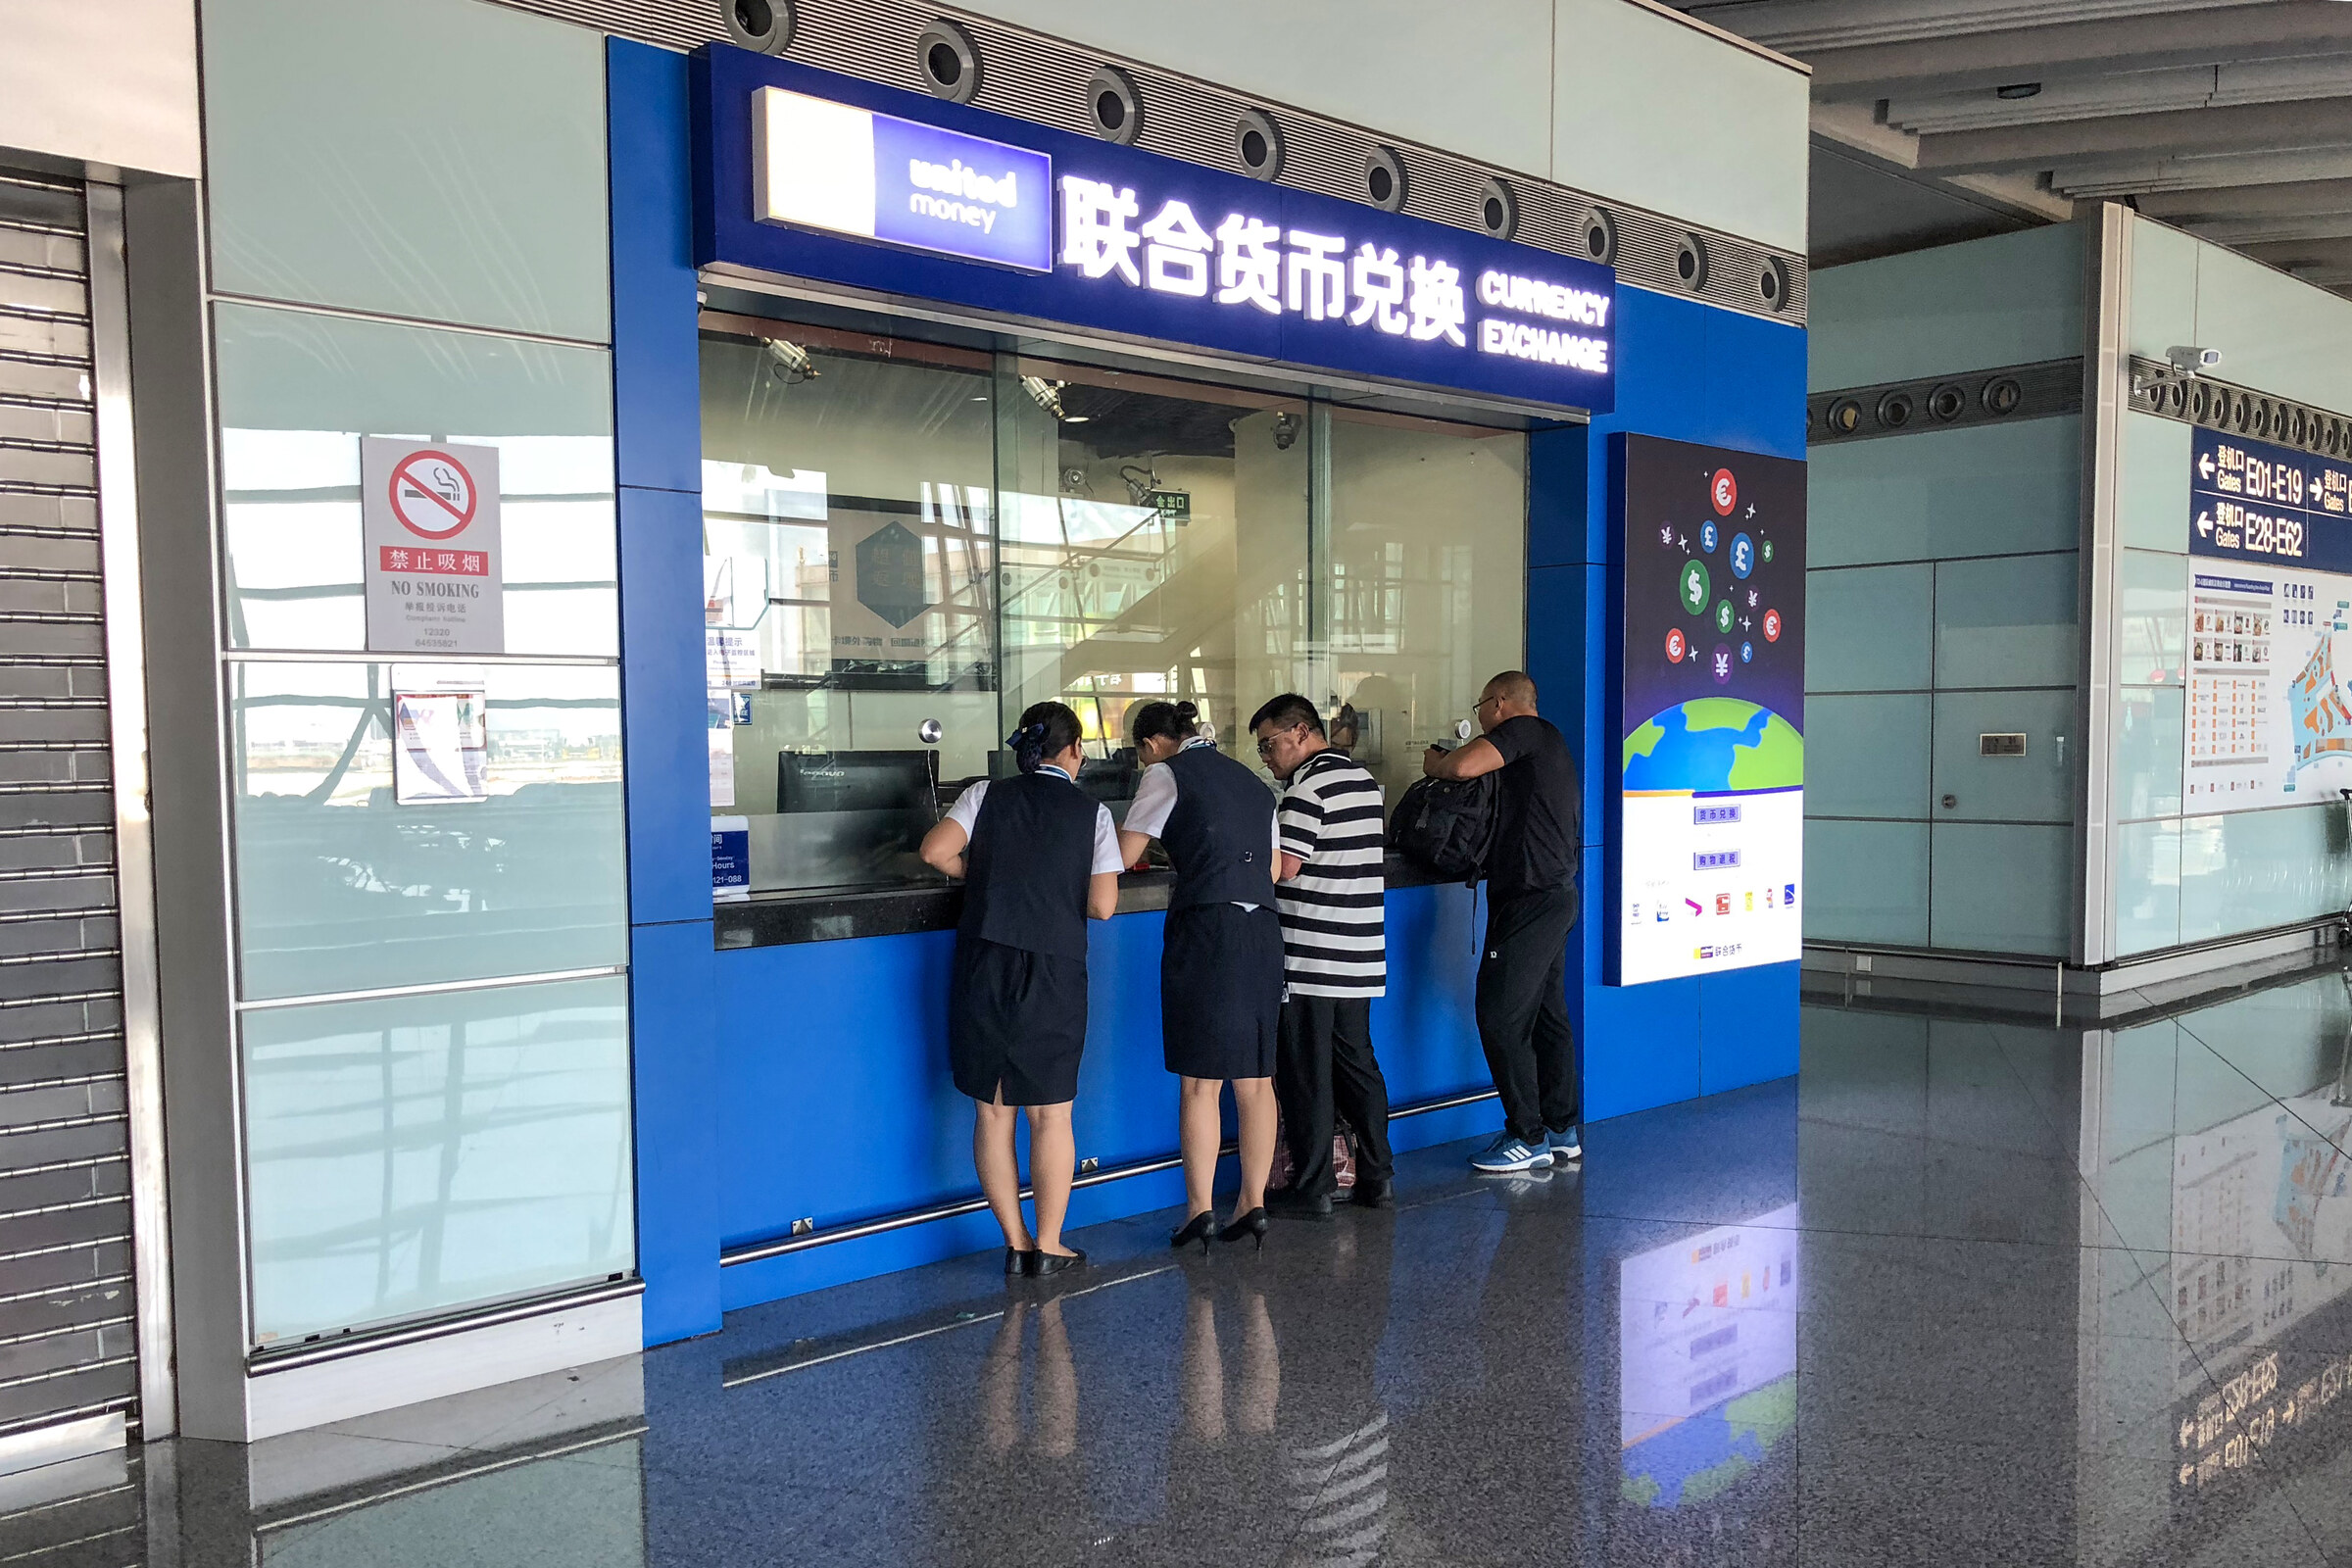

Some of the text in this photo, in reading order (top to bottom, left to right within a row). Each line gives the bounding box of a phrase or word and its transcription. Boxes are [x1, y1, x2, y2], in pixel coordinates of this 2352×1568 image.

[909, 159, 1017, 208] united
[909, 192, 997, 234] money
[1061, 177, 1467, 348] 联合货币兑换
[1482, 270, 1610, 328] CURRENCY
[1482, 322, 1609, 373] EXCHANGE
[2217, 471, 2241, 493] Gates
[2218, 444, 2302, 505] 登机口 E01-E19
[2324, 468, 2347, 493] 登机口
[1155, 495, 1185, 510] 全出口
[2324, 491, 2344, 513] Gates
[2216, 502, 2303, 558] 登机口 E28-E62
[2216, 527, 2240, 549] Gates
[390, 549, 480, 572] 禁止吸烟
[391, 580, 479, 598] NO SMOKING
[405, 602, 466, 613] 举报投诉电话
